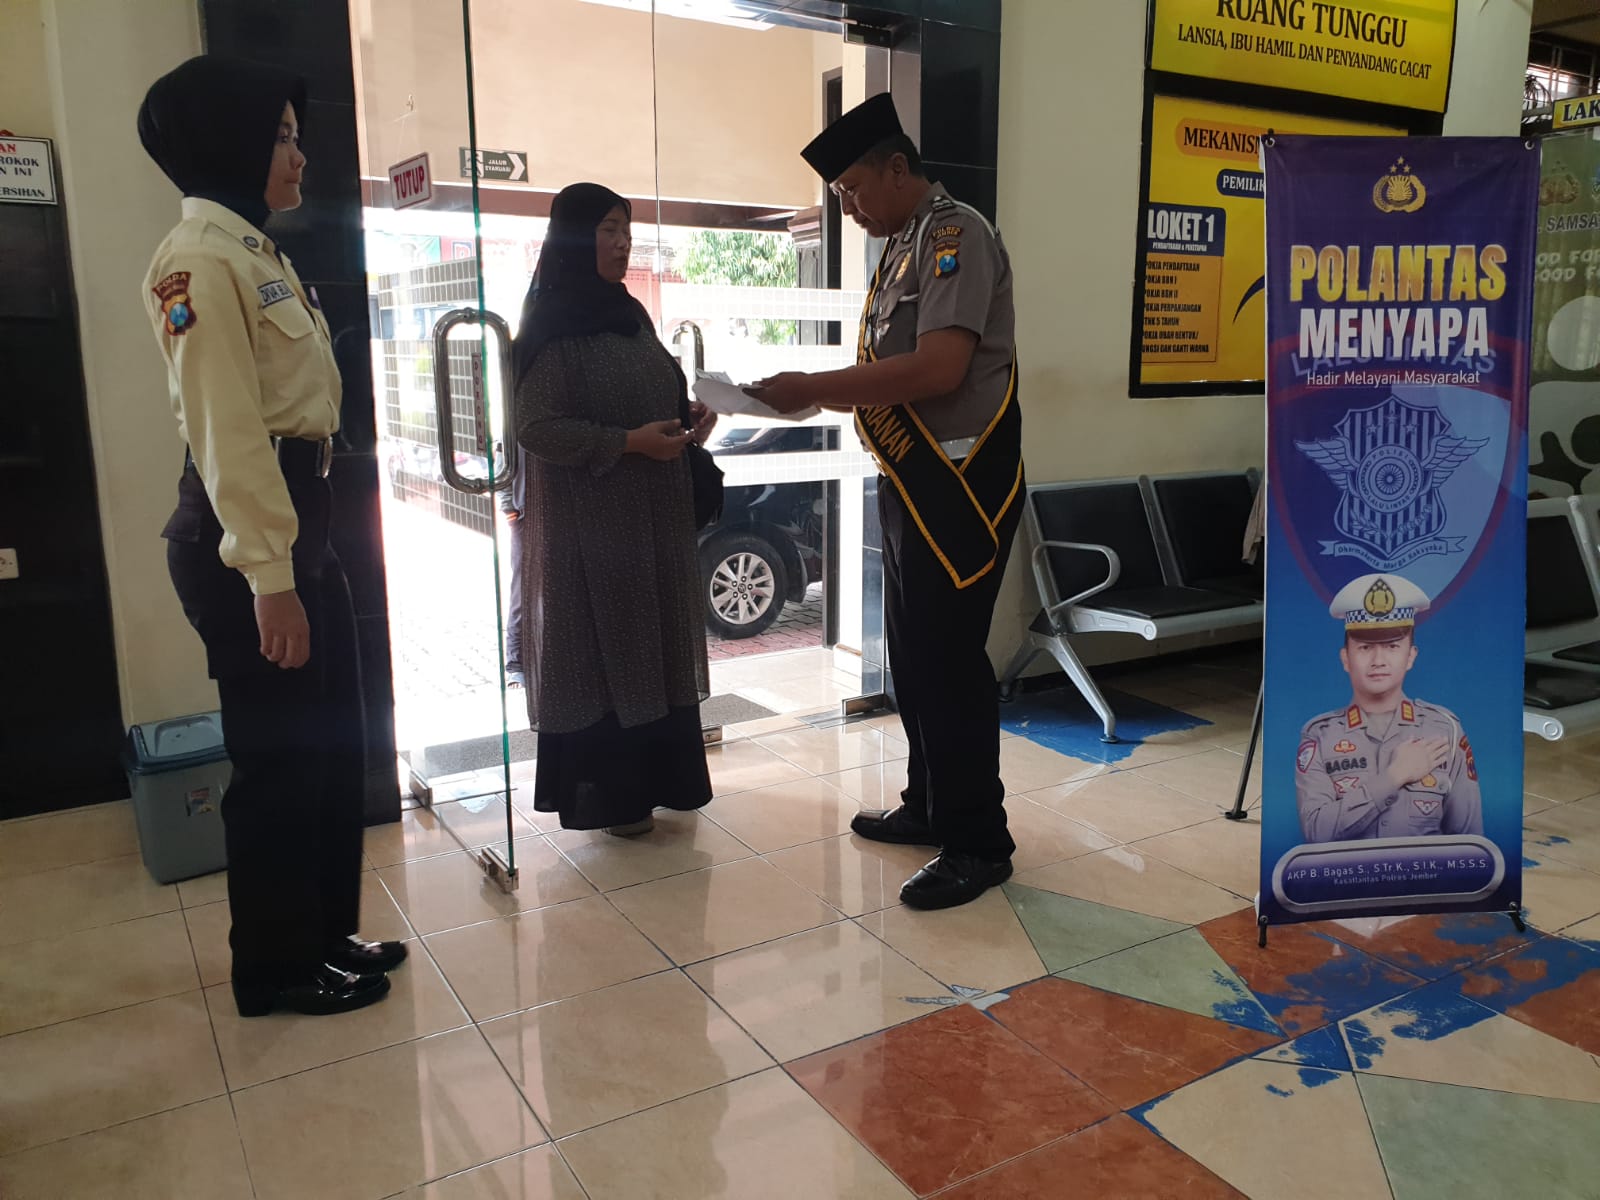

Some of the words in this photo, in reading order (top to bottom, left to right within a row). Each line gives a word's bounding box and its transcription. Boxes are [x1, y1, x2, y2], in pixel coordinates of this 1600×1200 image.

[1216, 0, 1306, 30] RUANG
[1312, 2, 1408, 48] TUNGGU
[1178, 23, 1228, 50] LANSIA,
[1230, 32, 1253, 52] IBU
[1255, 36, 1296, 59] HAMIL
[1298, 43, 1324, 63] DAN
[1326, 47, 1398, 75] PENYANDANG
[1399, 60, 1432, 80] CACAT
[14, 166, 32, 177] INI
[393, 165, 426, 201] TUTUP
[1147, 208, 1203, 242] LOKET
[1205, 213, 1216, 243] 1
[1289, 243, 1508, 303] POLANTAS
[1299, 307, 1489, 358] MENYAPA
[1307, 371, 1341, 385] Hadir
[1344, 371, 1400, 388] Melayani
[1404, 370, 1480, 387] Masyarakat
[1325, 756, 1368, 775] BAGAS
[1287, 869, 1307, 881] AKP
[1323, 866, 1354, 878] Bagas
